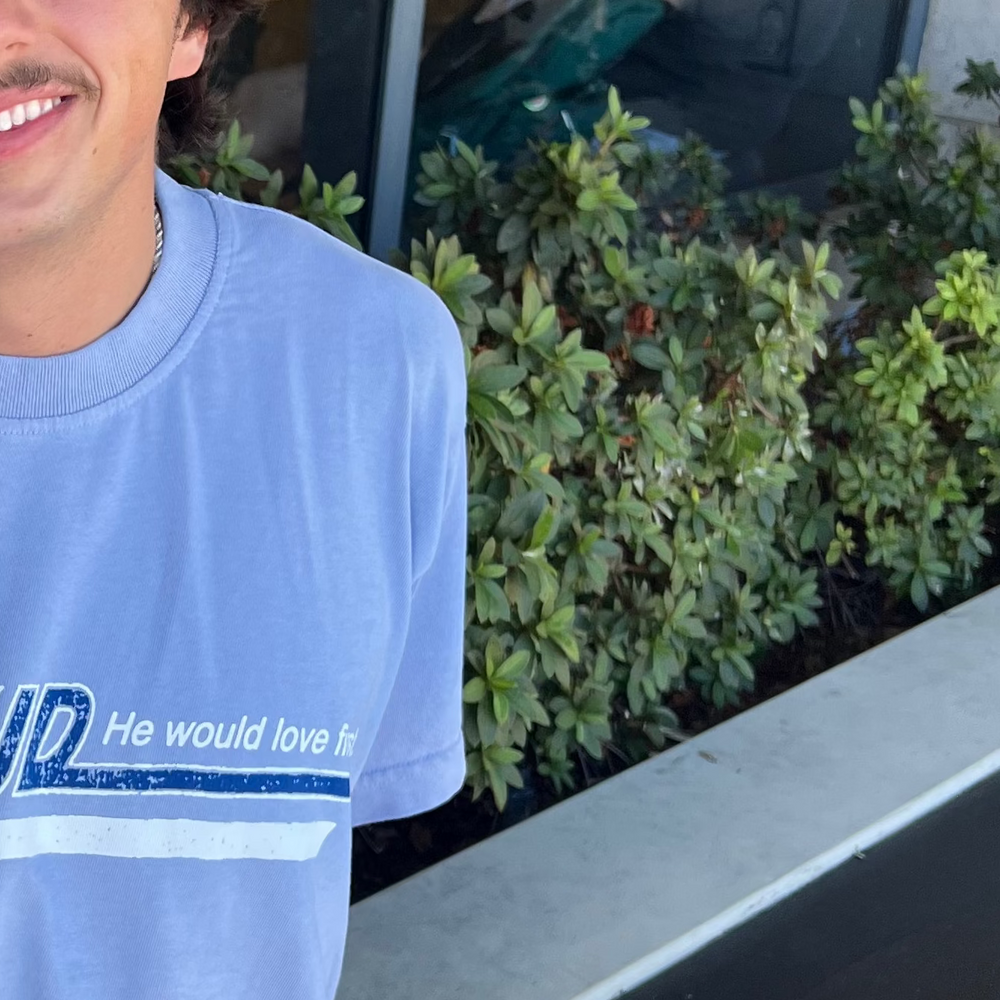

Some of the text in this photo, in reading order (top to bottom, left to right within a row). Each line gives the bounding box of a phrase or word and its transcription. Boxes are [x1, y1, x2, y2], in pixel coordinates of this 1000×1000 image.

[102, 711, 154, 746] He
[166, 715, 267, 750] would
[271, 717, 329, 755] love
